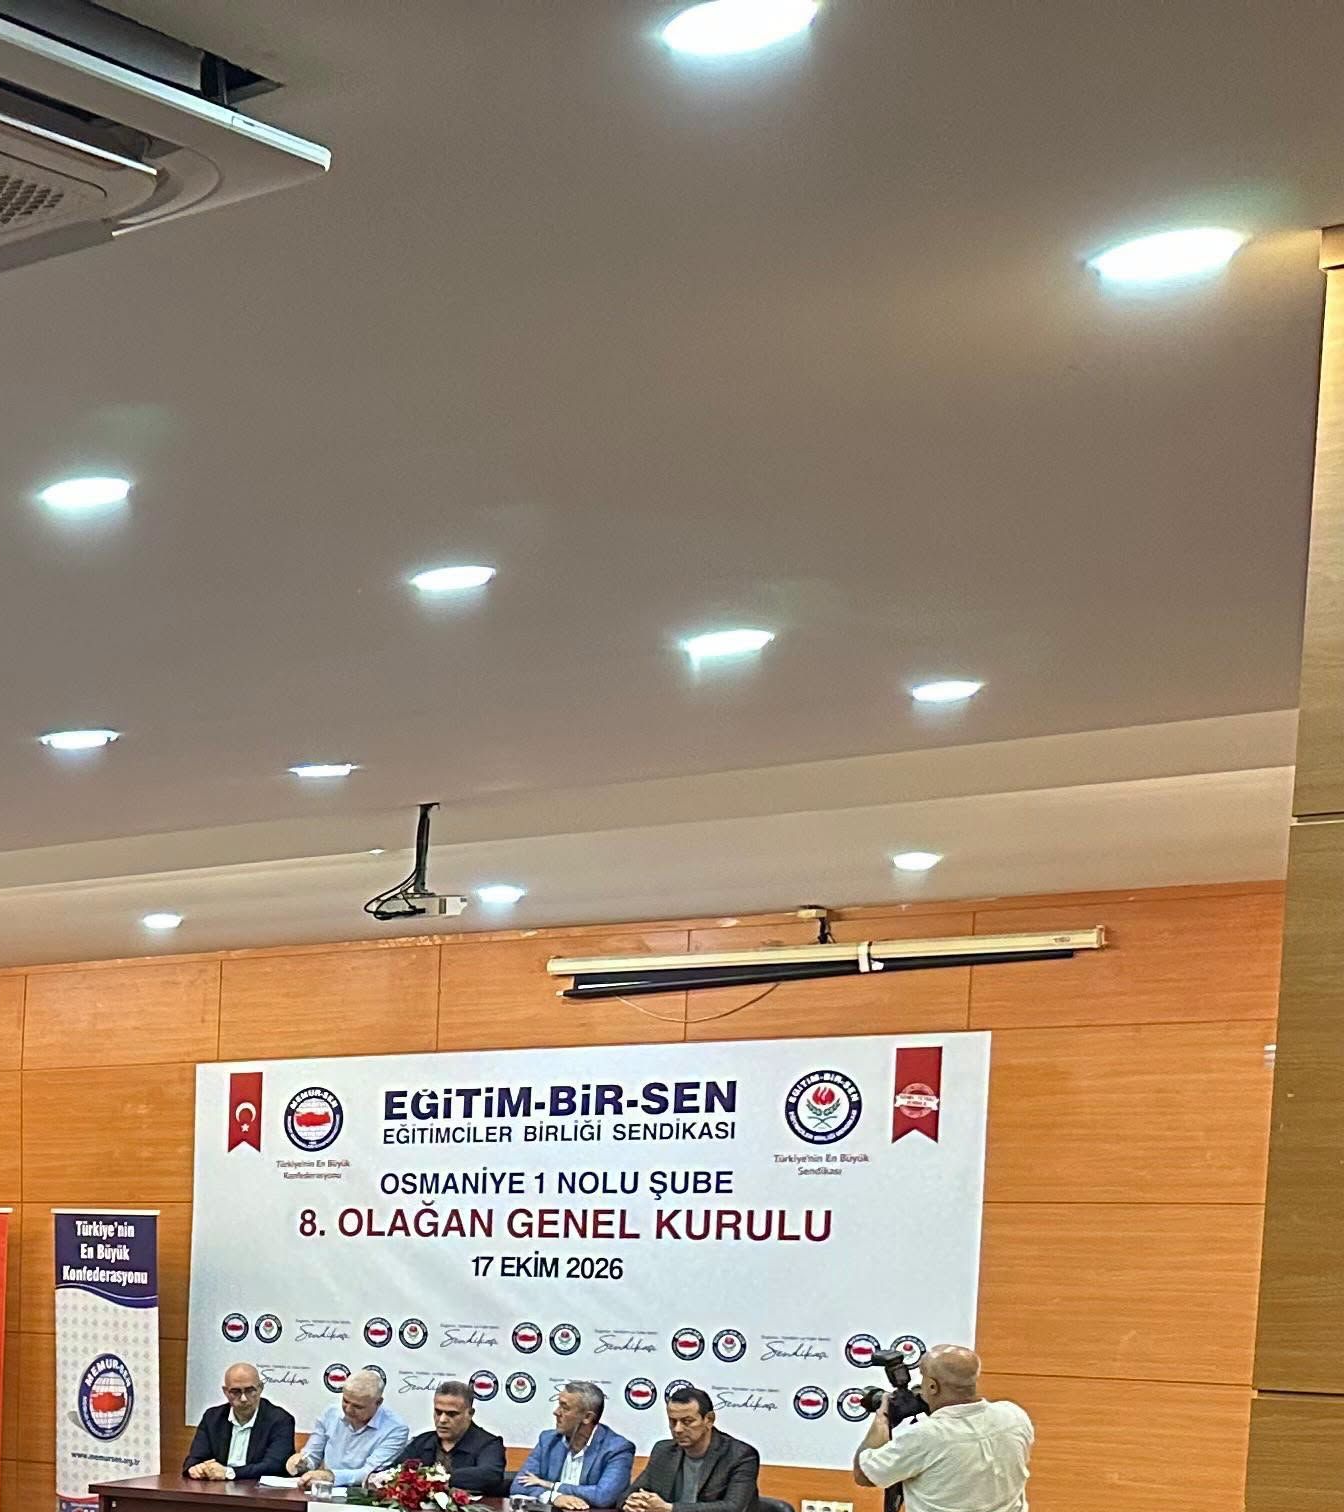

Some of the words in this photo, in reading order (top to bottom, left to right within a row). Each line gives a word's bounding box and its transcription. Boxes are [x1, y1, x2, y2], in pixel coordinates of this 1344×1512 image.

[383, 1122, 512, 1144] EĞİTİMCİLER
[523, 1119, 601, 1142] BİRLİĞİ
[613, 1118, 735, 1141] SENDİKASI
[380, 1166, 525, 1194] OSMANİYE
[534, 1172, 545, 1194] 1
[558, 1171, 639, 1194] NOLU
[649, 1170, 733, 1200] ŞUBE
[75, 1220, 135, 1240] Türkiye'nin
[299, 1209, 325, 1236] 8.
[338, 1200, 493, 1238] OLAĞAN
[507, 1208, 640, 1239] GENEL
[656, 1209, 832, 1241] KURULU
[80, 1243, 94, 1259] En
[97, 1243, 130, 1264] Büyük
[471, 1256, 494, 1277] 17
[501, 1251, 559, 1278] EKİM
[566, 1257, 624, 1279] 2026
[62, 1265, 148, 1287] Konfederasyonu
